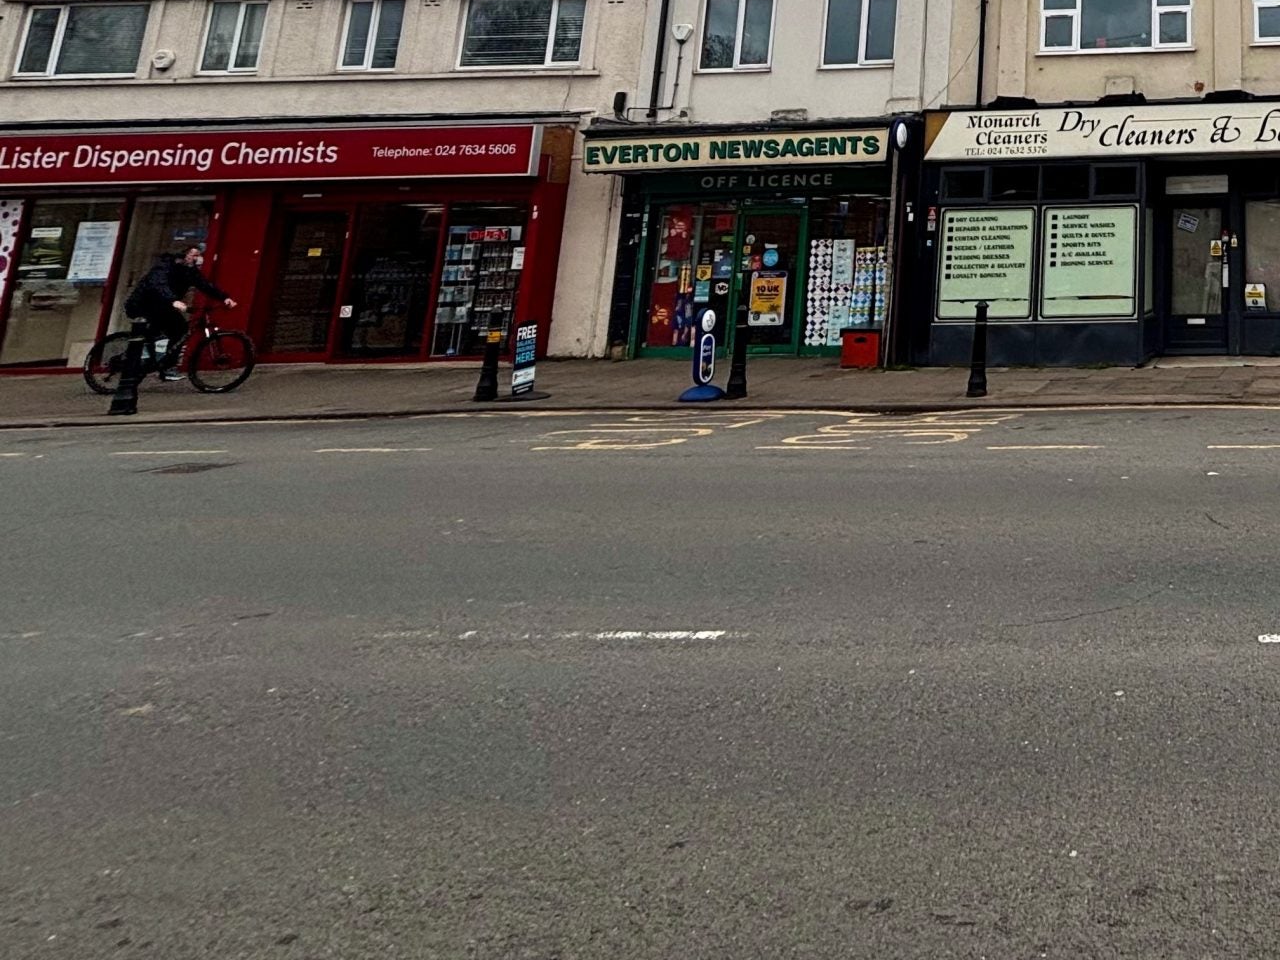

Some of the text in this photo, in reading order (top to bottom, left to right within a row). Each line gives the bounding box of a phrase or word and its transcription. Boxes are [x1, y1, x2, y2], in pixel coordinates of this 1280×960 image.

[966, 112, 1041, 128] Monarch
[1056, 111, 1100, 138] Dry
[1099, 115, 1197, 147] Cleaners
[1210, 116, 1241, 143] &
[976, 130, 1048, 145] Cleaners
[0, 141, 338, 172] Lister Dispensing Chemists
[372, 143, 516, 158] Telephone: 024 7634 5606
[586, 136, 880, 166] EVERTON NEWSAGENTS
[965, 146, 1048, 156] TEL: 024 7632 5376
[701, 173, 833, 188] OFF LICENCE
[469, 228, 508, 240] OPEN
[517, 324, 538, 340] FREE
[516, 351, 536, 364] HERE
